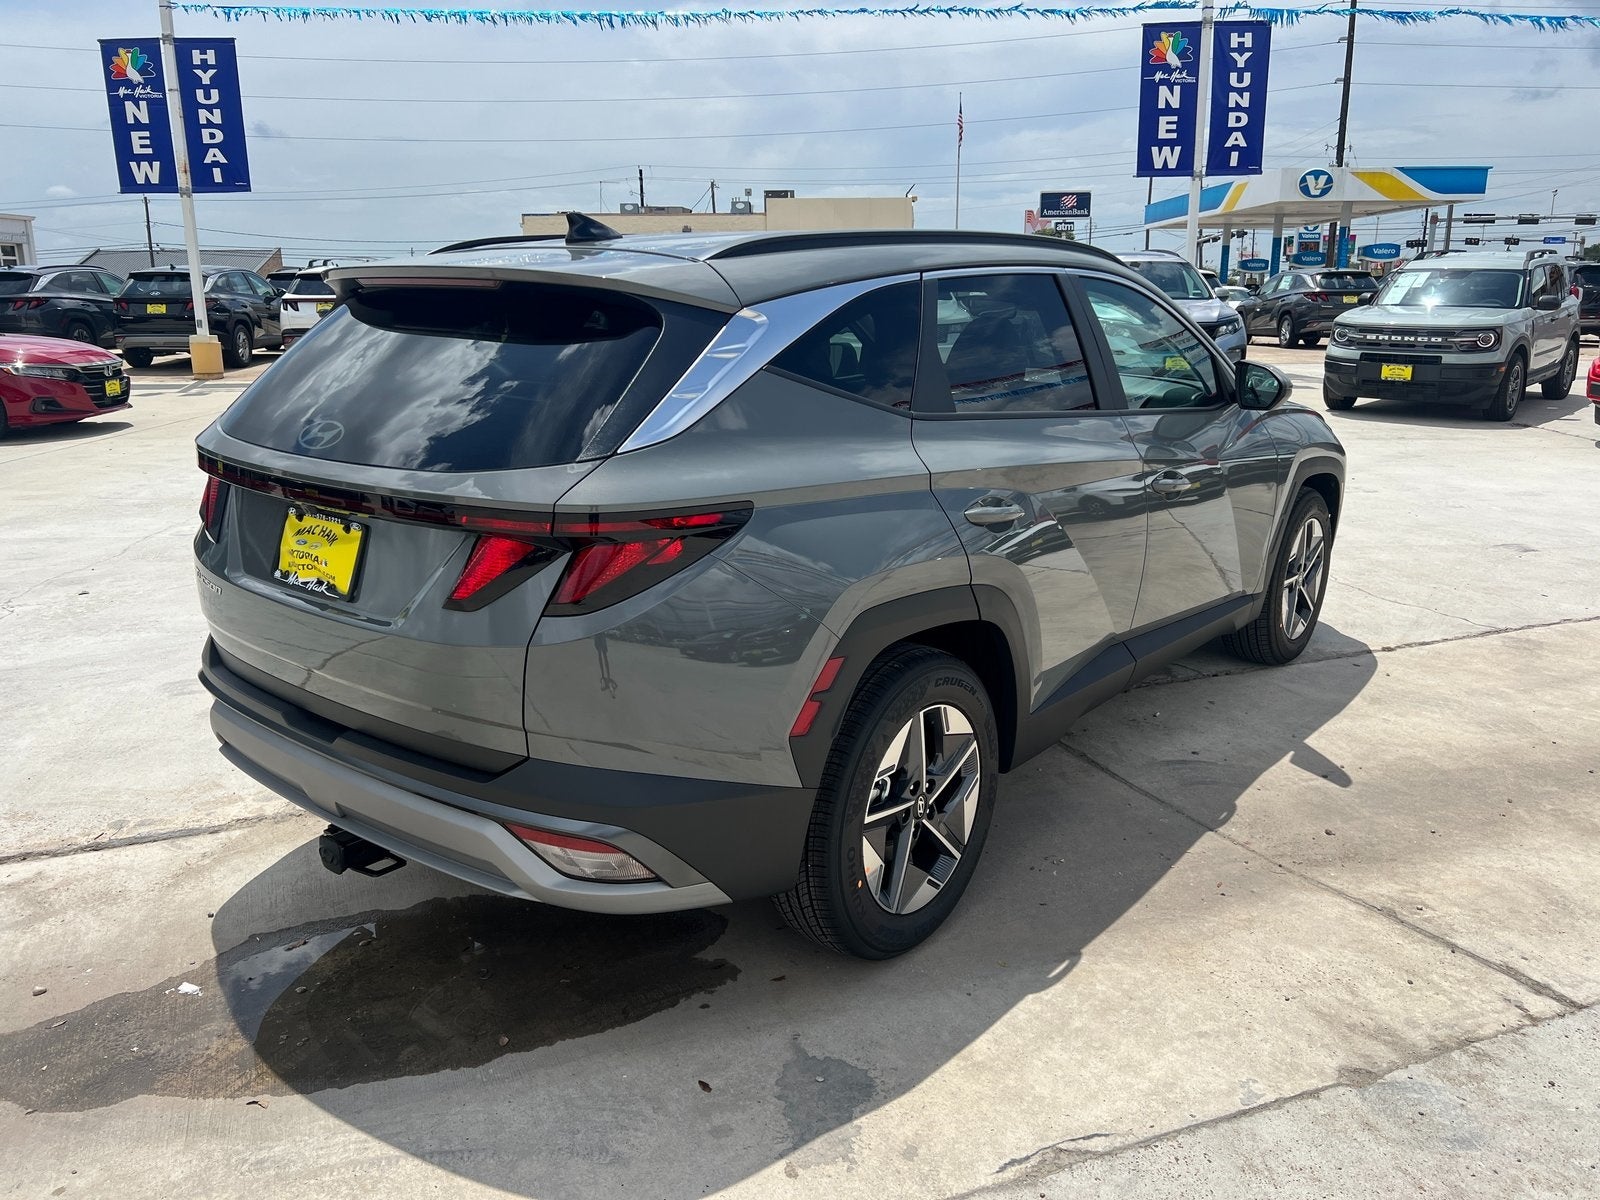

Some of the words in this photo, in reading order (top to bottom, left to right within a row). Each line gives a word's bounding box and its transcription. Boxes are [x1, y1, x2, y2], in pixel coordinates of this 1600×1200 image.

[1224, 32, 1253, 167] HYUNDAI
[191, 49, 228, 183] HYUNDAI
[1151, 85, 1182, 169] NEW
[124, 100, 161, 185] NEW
[1042, 208, 1089, 216] AmericanBank
[1056, 223, 1074, 231] atm
[1372, 247, 1396, 255] Valero
[1366, 334, 1443, 342] BRONCO
[292, 524, 318, 538] MAC
[317, 526, 339, 547] HAIK
